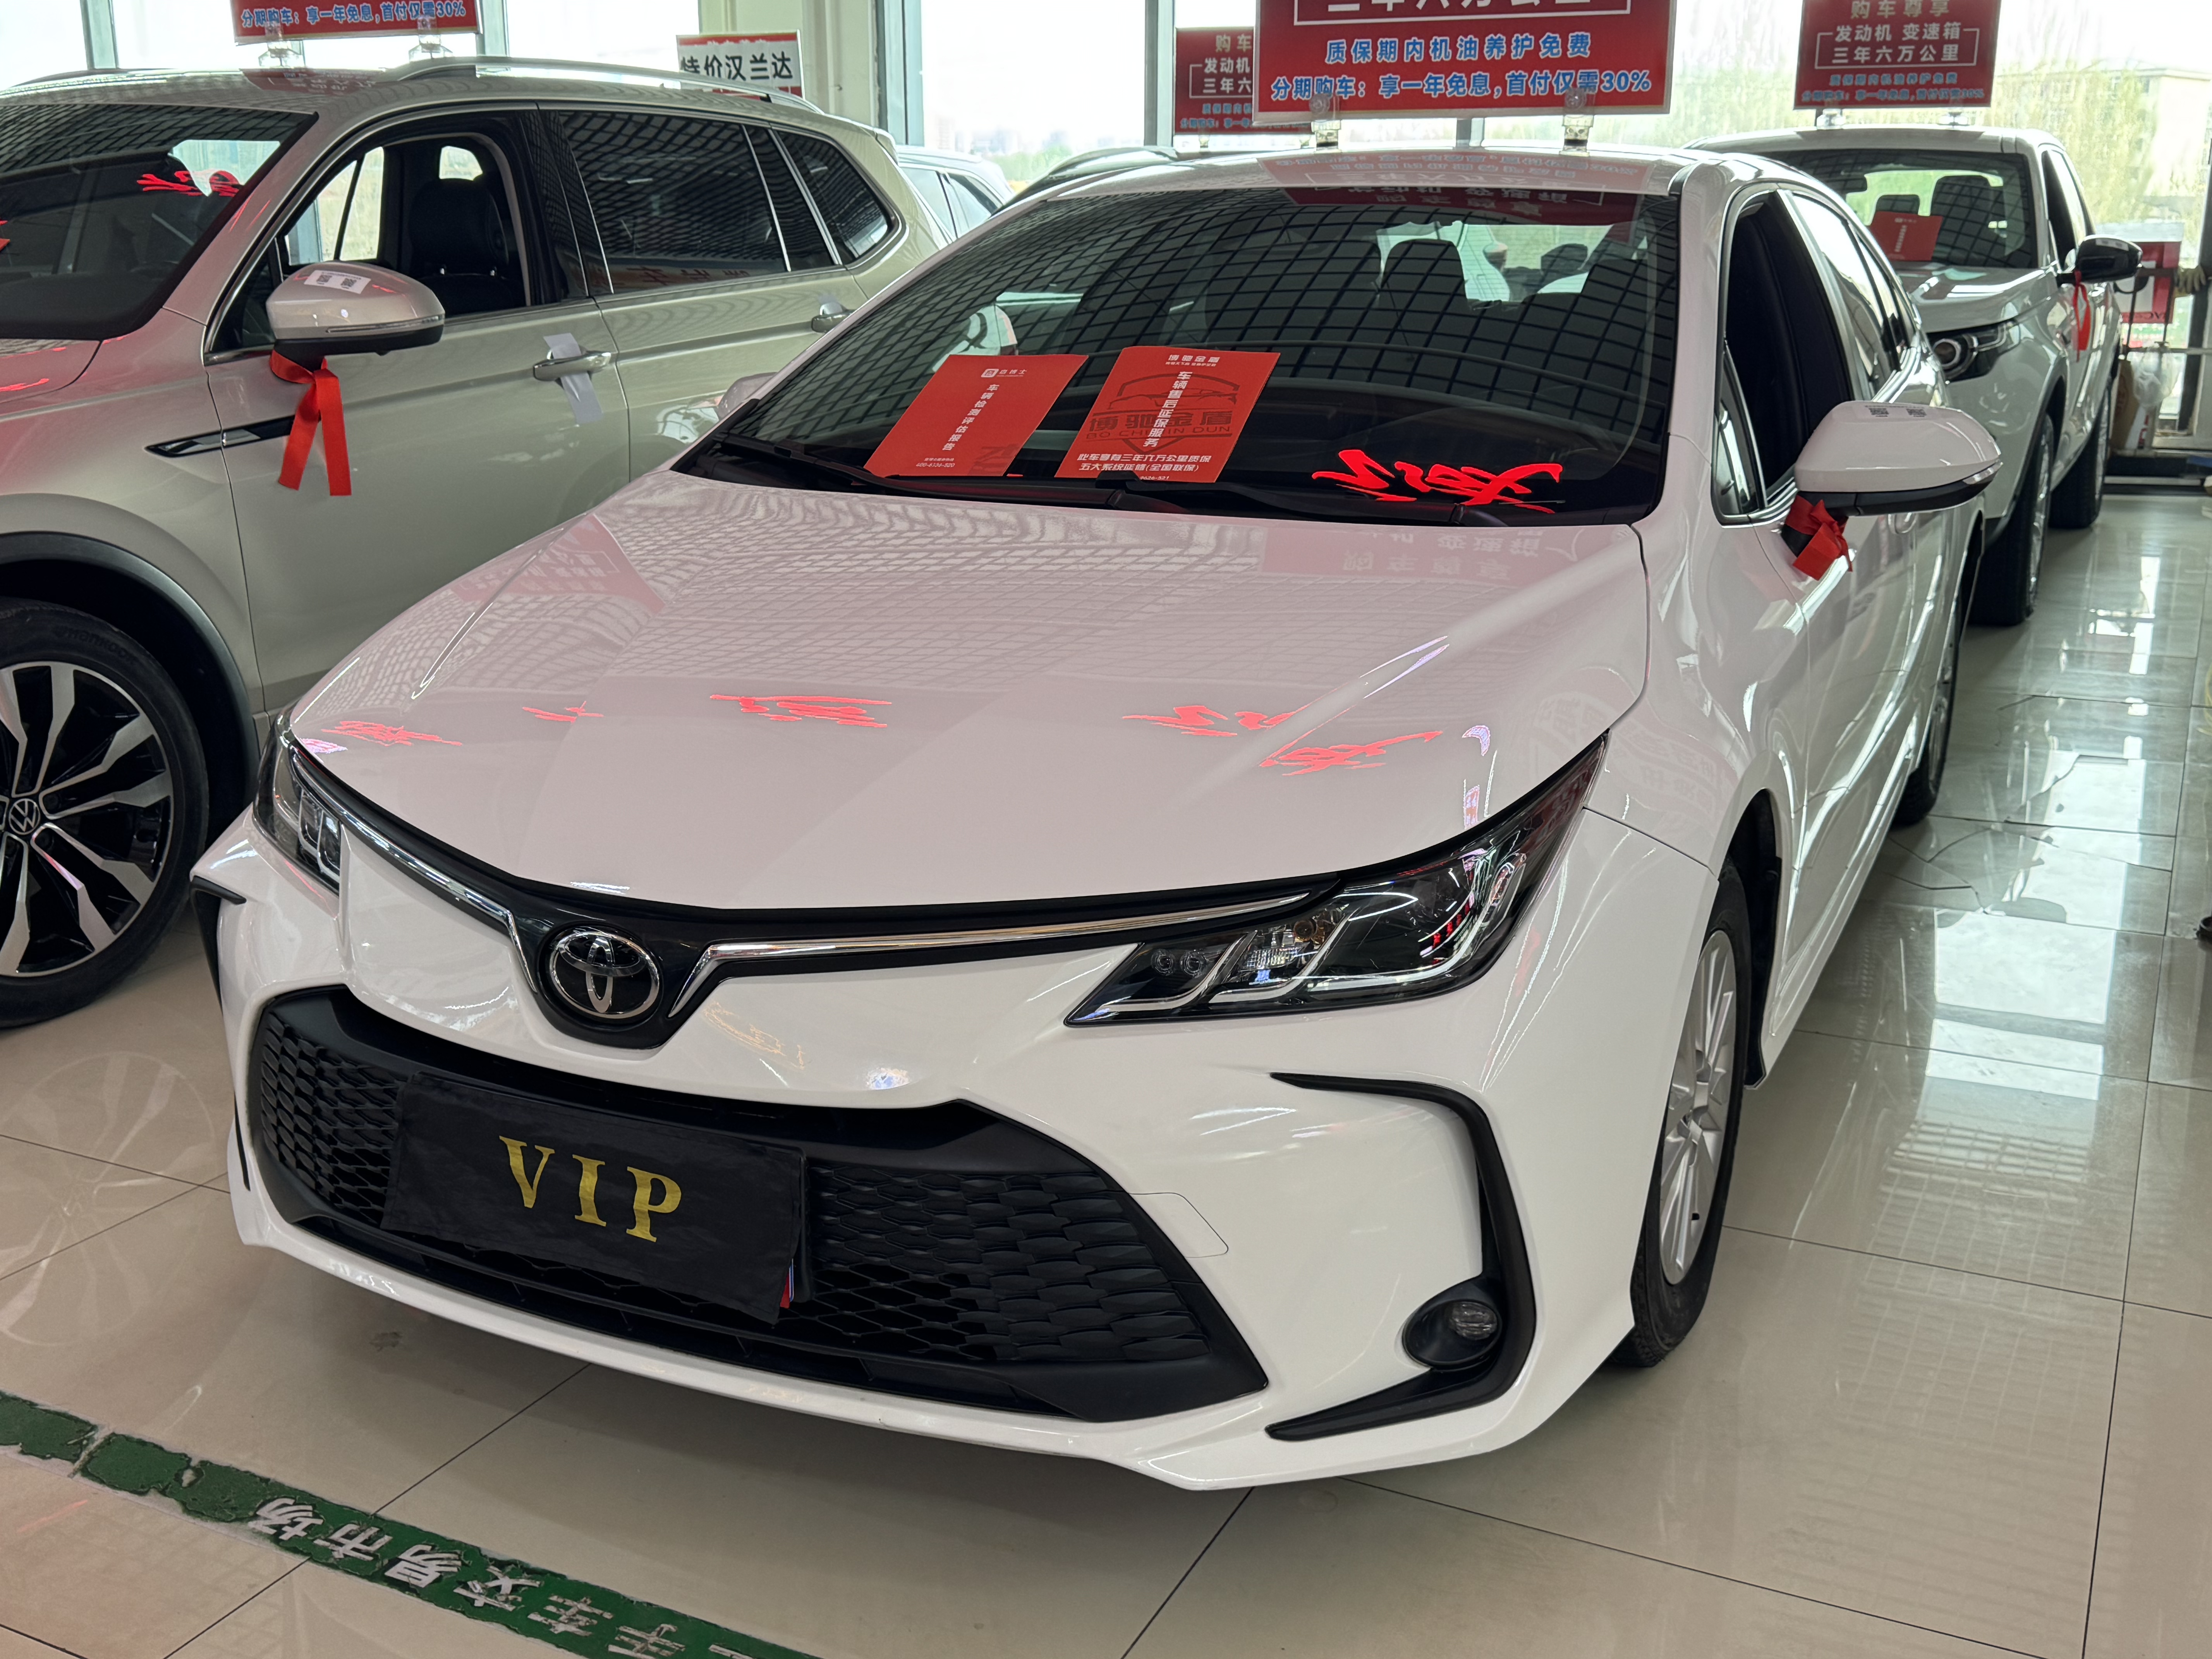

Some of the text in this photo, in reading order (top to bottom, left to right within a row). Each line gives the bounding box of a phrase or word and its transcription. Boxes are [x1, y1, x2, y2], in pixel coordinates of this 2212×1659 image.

[1835, 22, 1961, 42] 发动机 变速箱
[1326, 32, 1591, 64] 质保期内机油养护免费
[1832, 44, 1959, 64] 三年六万公里
[680, 50, 793, 81] 特价汉兰达
[1204, 57, 1250, 74] 发动机
[1203, 77, 1251, 93] 三年六
[1143, 371, 1193, 447] 车辆售后延保服务
[499, 1135, 682, 1242] VIP
